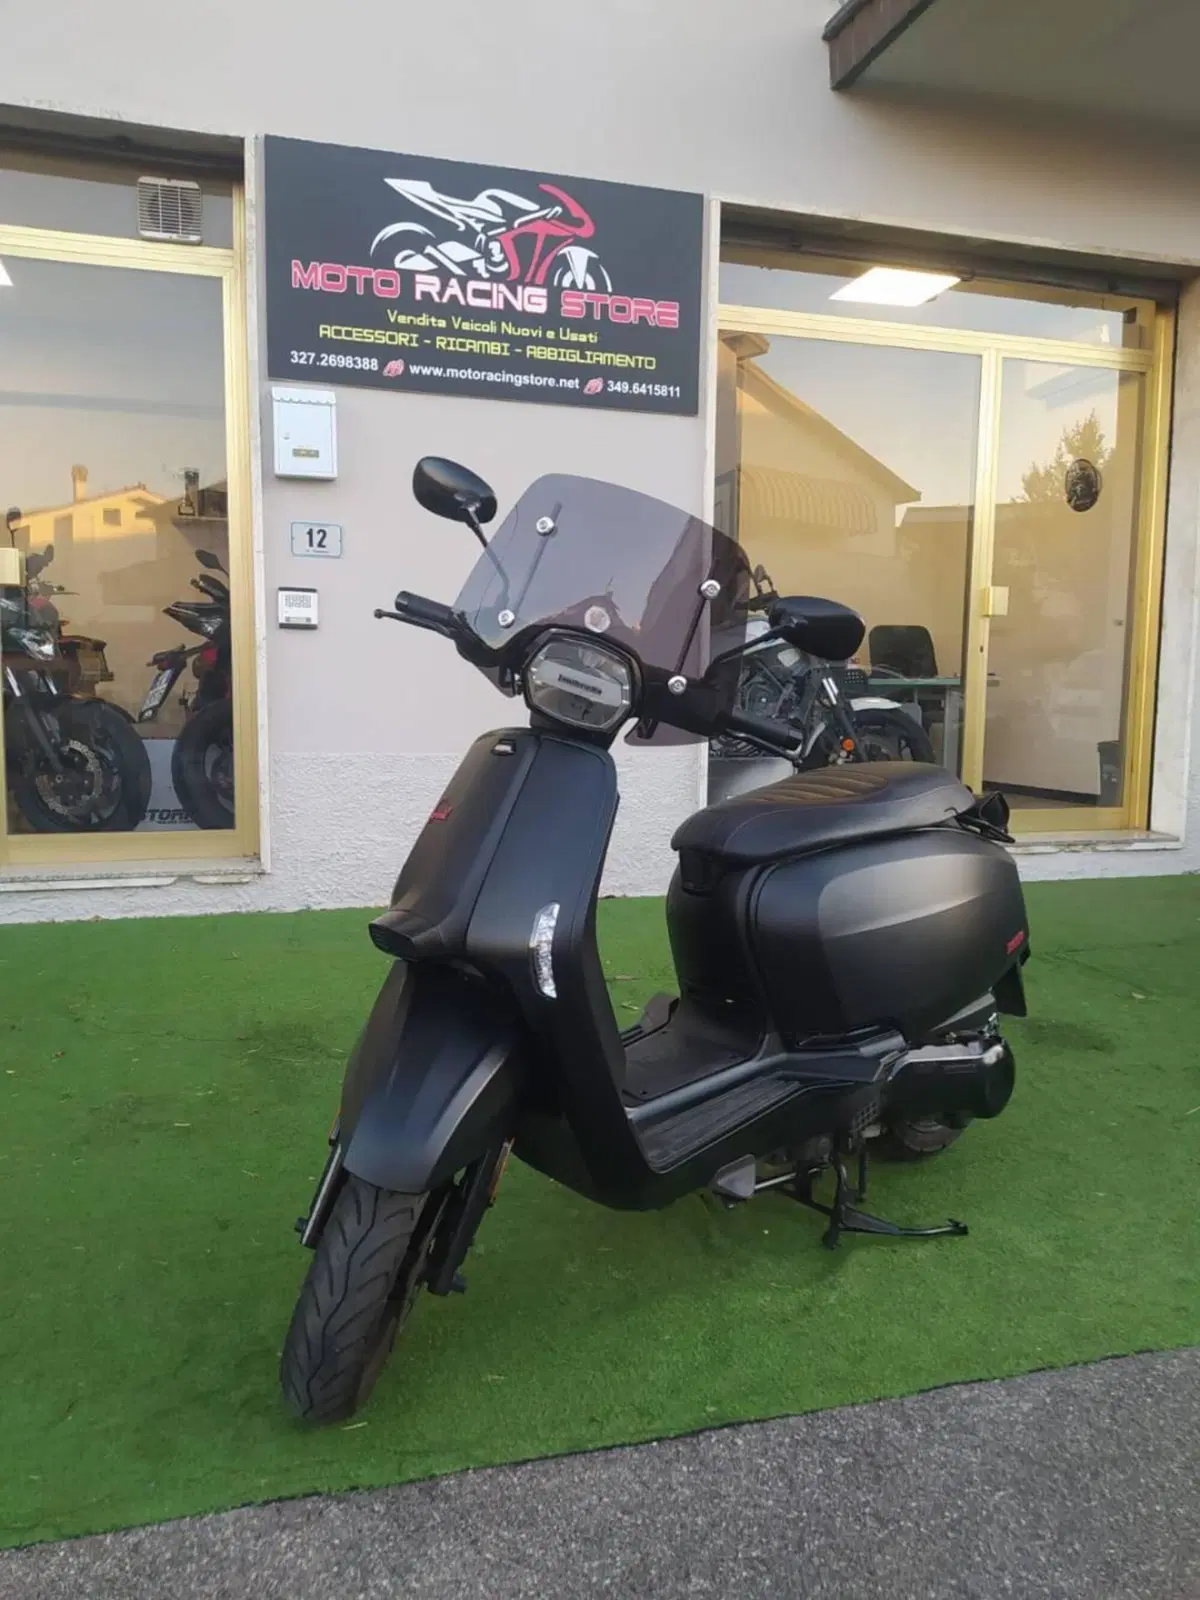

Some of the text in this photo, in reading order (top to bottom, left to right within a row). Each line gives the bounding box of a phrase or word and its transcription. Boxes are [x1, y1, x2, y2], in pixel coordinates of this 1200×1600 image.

[291, 259, 680, 329] MOTO RACING STORE
[319, 324, 419, 347] ACCESSORI
[436, 336, 510, 357] RICAMBI
[526, 345, 657, 370] ABBIGLIAMENTO
[387, 309, 598, 343] Vendita Veicoli Nuovi e Usati
[290, 351, 681, 398] 327.2698388 www.motoracingstore.net 349.6415811
[306, 528, 327, 548] 12
